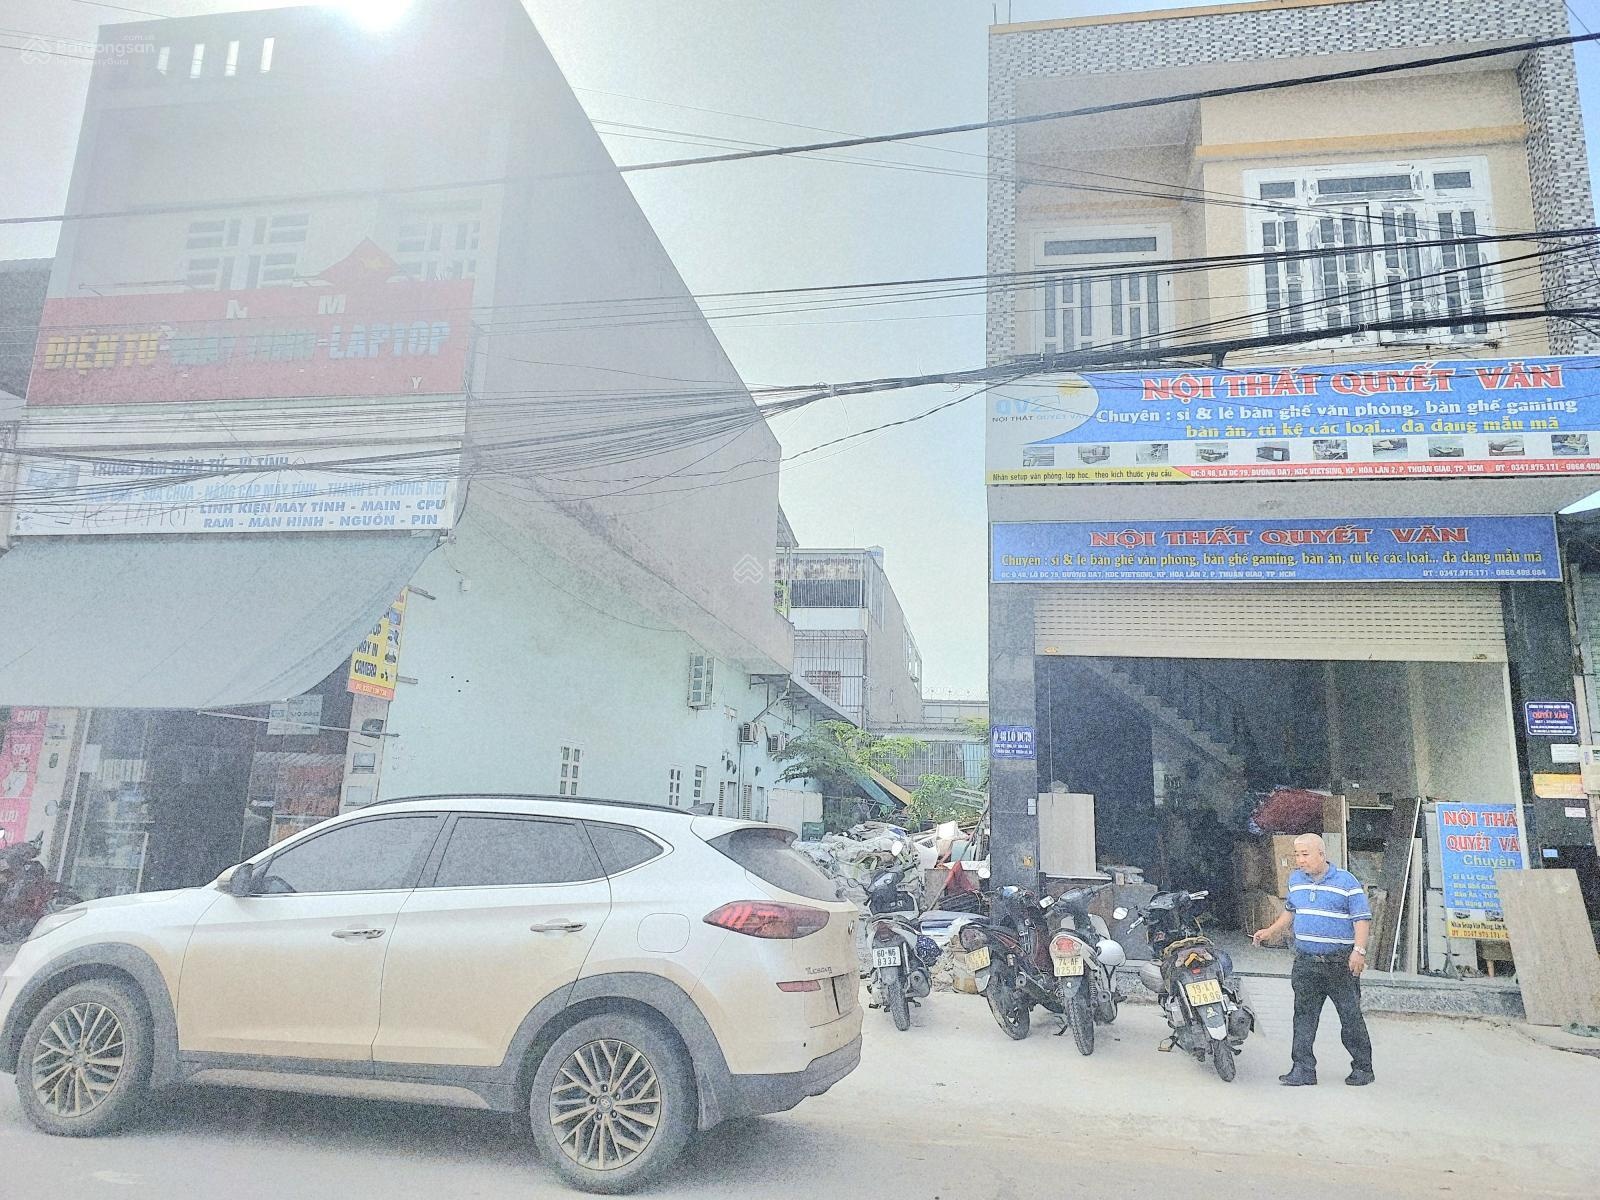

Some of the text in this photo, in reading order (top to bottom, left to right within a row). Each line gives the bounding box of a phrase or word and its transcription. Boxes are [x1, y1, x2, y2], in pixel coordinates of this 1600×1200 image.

[1141, 361, 1565, 404] NỘI THẤT QUYẾT VĂN
[1096, 409, 1160, 424] Chuyên
[1196, 407, 1212, 420] &
[1240, 405, 1273, 419] bàn
[1279, 402, 1312, 420] ghế
[1317, 404, 1349, 417] văn
[1425, 400, 1461, 414] bàn
[1467, 398, 1501, 415] ghế
[1506, 398, 1578, 414] gaming
[1186, 424, 1219, 438] bàn
[361, 500, 401, 511] MAIN
[416, 499, 446, 510] CPU
[203, 518, 234, 528] RAM
[411, 514, 438, 525] PIN
[1089, 523, 1470, 549] NỘI THẤT QUYẾT VĂN
[1063, 553, 1073, 565] &
[1443, 808, 1478, 828] NỘI
[1446, 831, 1492, 853] QUYẾT
